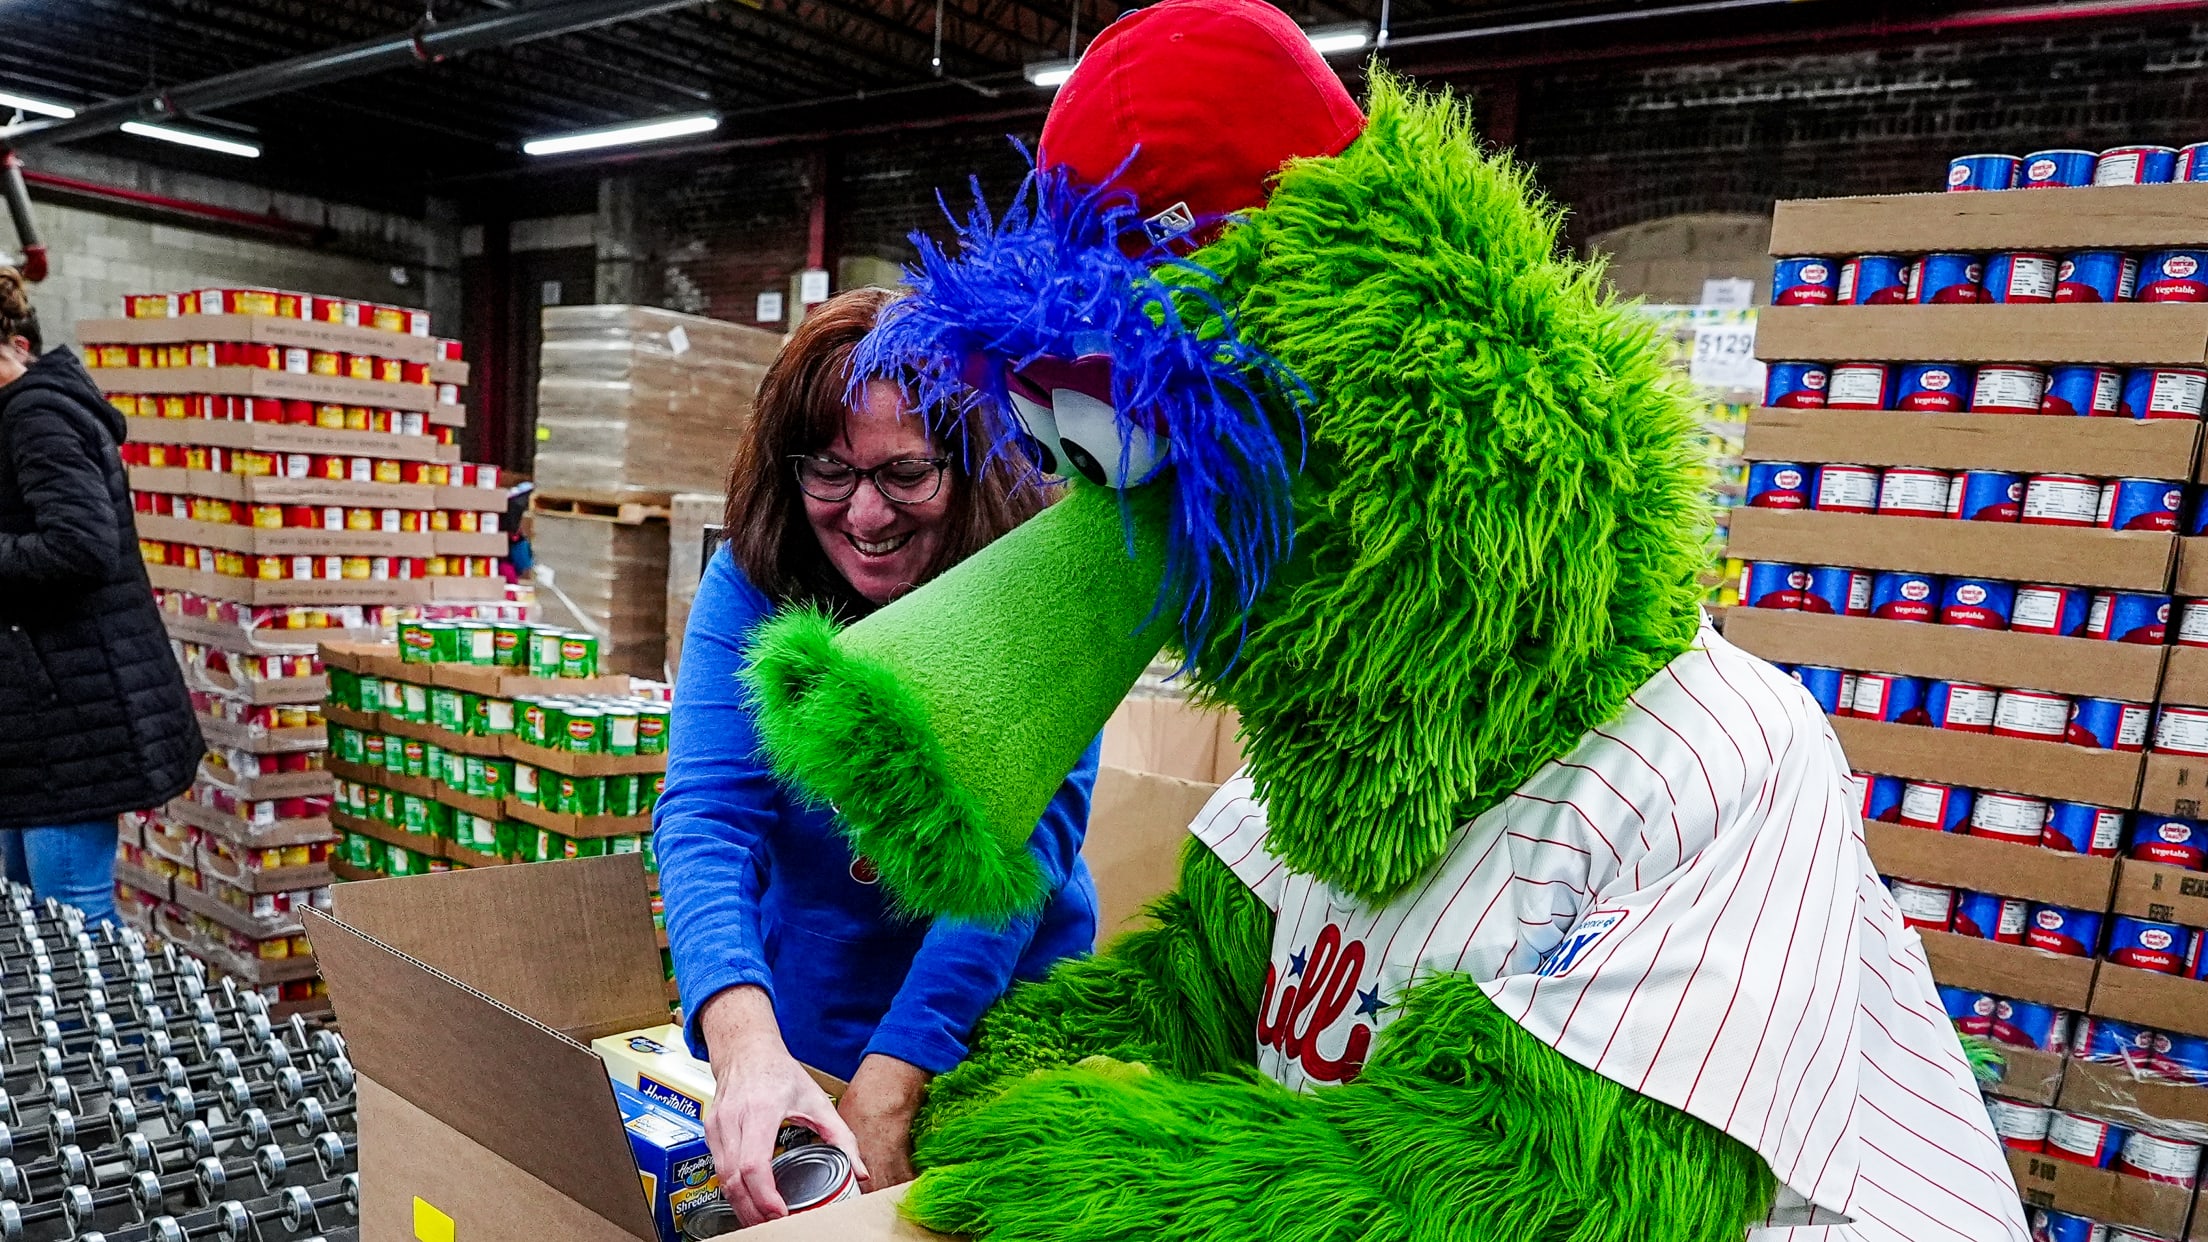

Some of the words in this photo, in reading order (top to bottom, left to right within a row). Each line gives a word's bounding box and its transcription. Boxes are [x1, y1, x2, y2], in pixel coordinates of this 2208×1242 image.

[2168, 259, 2194, 267] American
[1794, 290, 1828, 299] Vegetable
[2155, 286, 2196, 295] Vegetable
[1699, 334, 1752, 354] 5129
[1914, 397, 1950, 406] Vegetable
[1769, 495, 1801, 504] Vegetable
[1894, 606, 1929, 615] Vegetable
[2151, 847, 2190, 859] Vegetable
[2132, 952, 2170, 964] Vegetable
[643, 1084, 697, 1118] Hospitality
[685, 1184, 708, 1199] Original
[675, 1187, 718, 1214] Shredded
